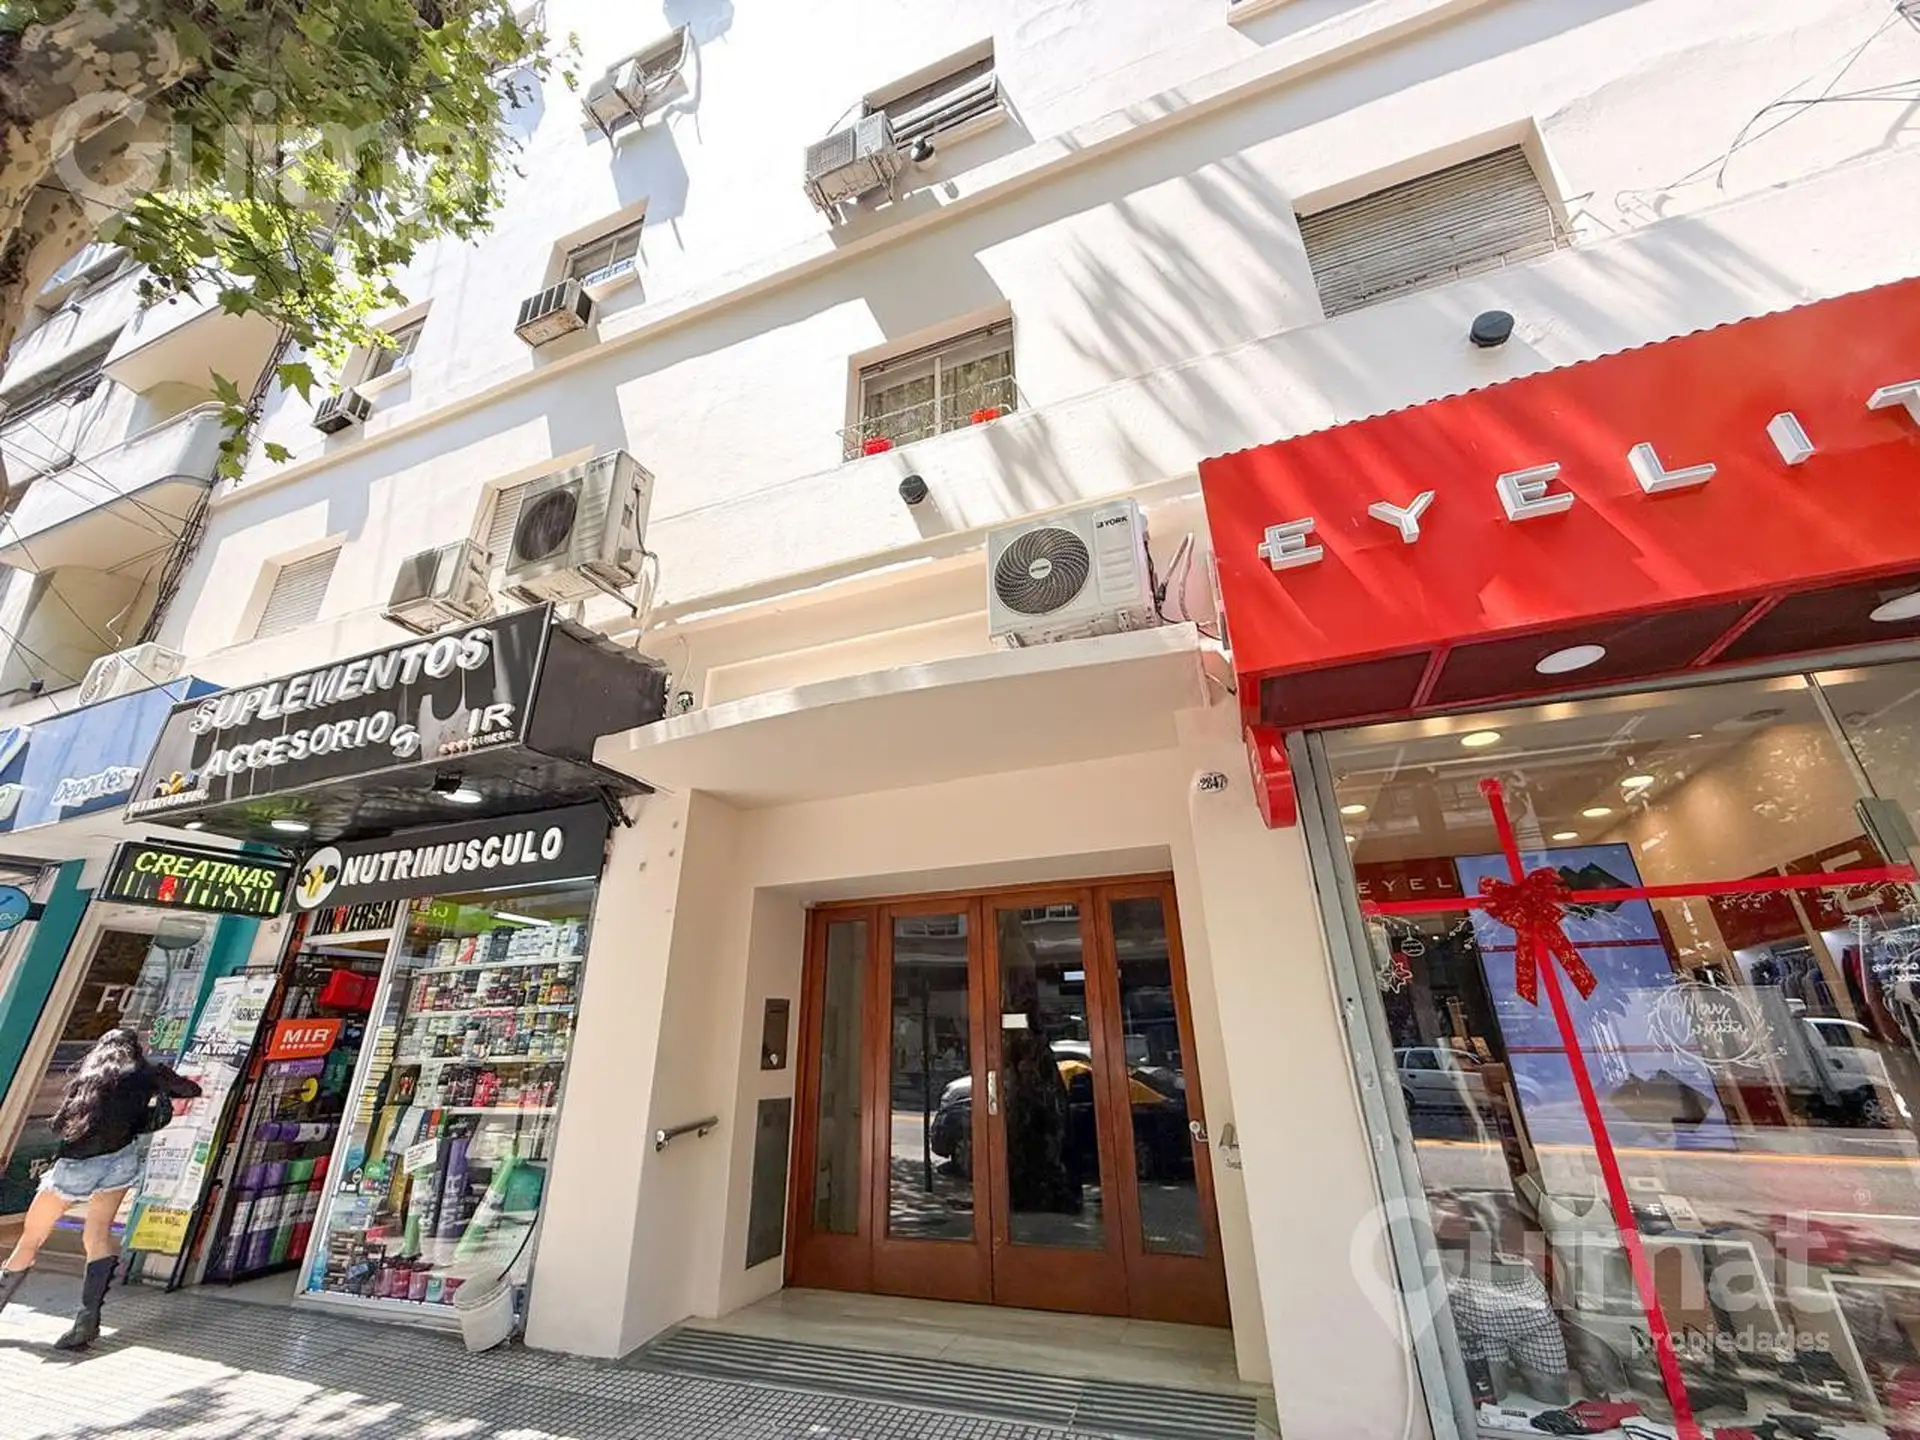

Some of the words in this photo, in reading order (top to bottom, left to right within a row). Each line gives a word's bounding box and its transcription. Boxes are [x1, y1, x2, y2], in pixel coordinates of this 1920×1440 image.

[1104, 514, 1128, 527] YORK
[189, 627, 493, 735] SUPLEMENTOS
[200, 710, 421, 779] ACCESORIOS
[1199, 774, 1226, 790] 2847
[135, 851, 276, 889] CREATINAS
[340, 826, 564, 887] NUTRIMUSCULO
[282, 1028, 331, 1043] MIR
